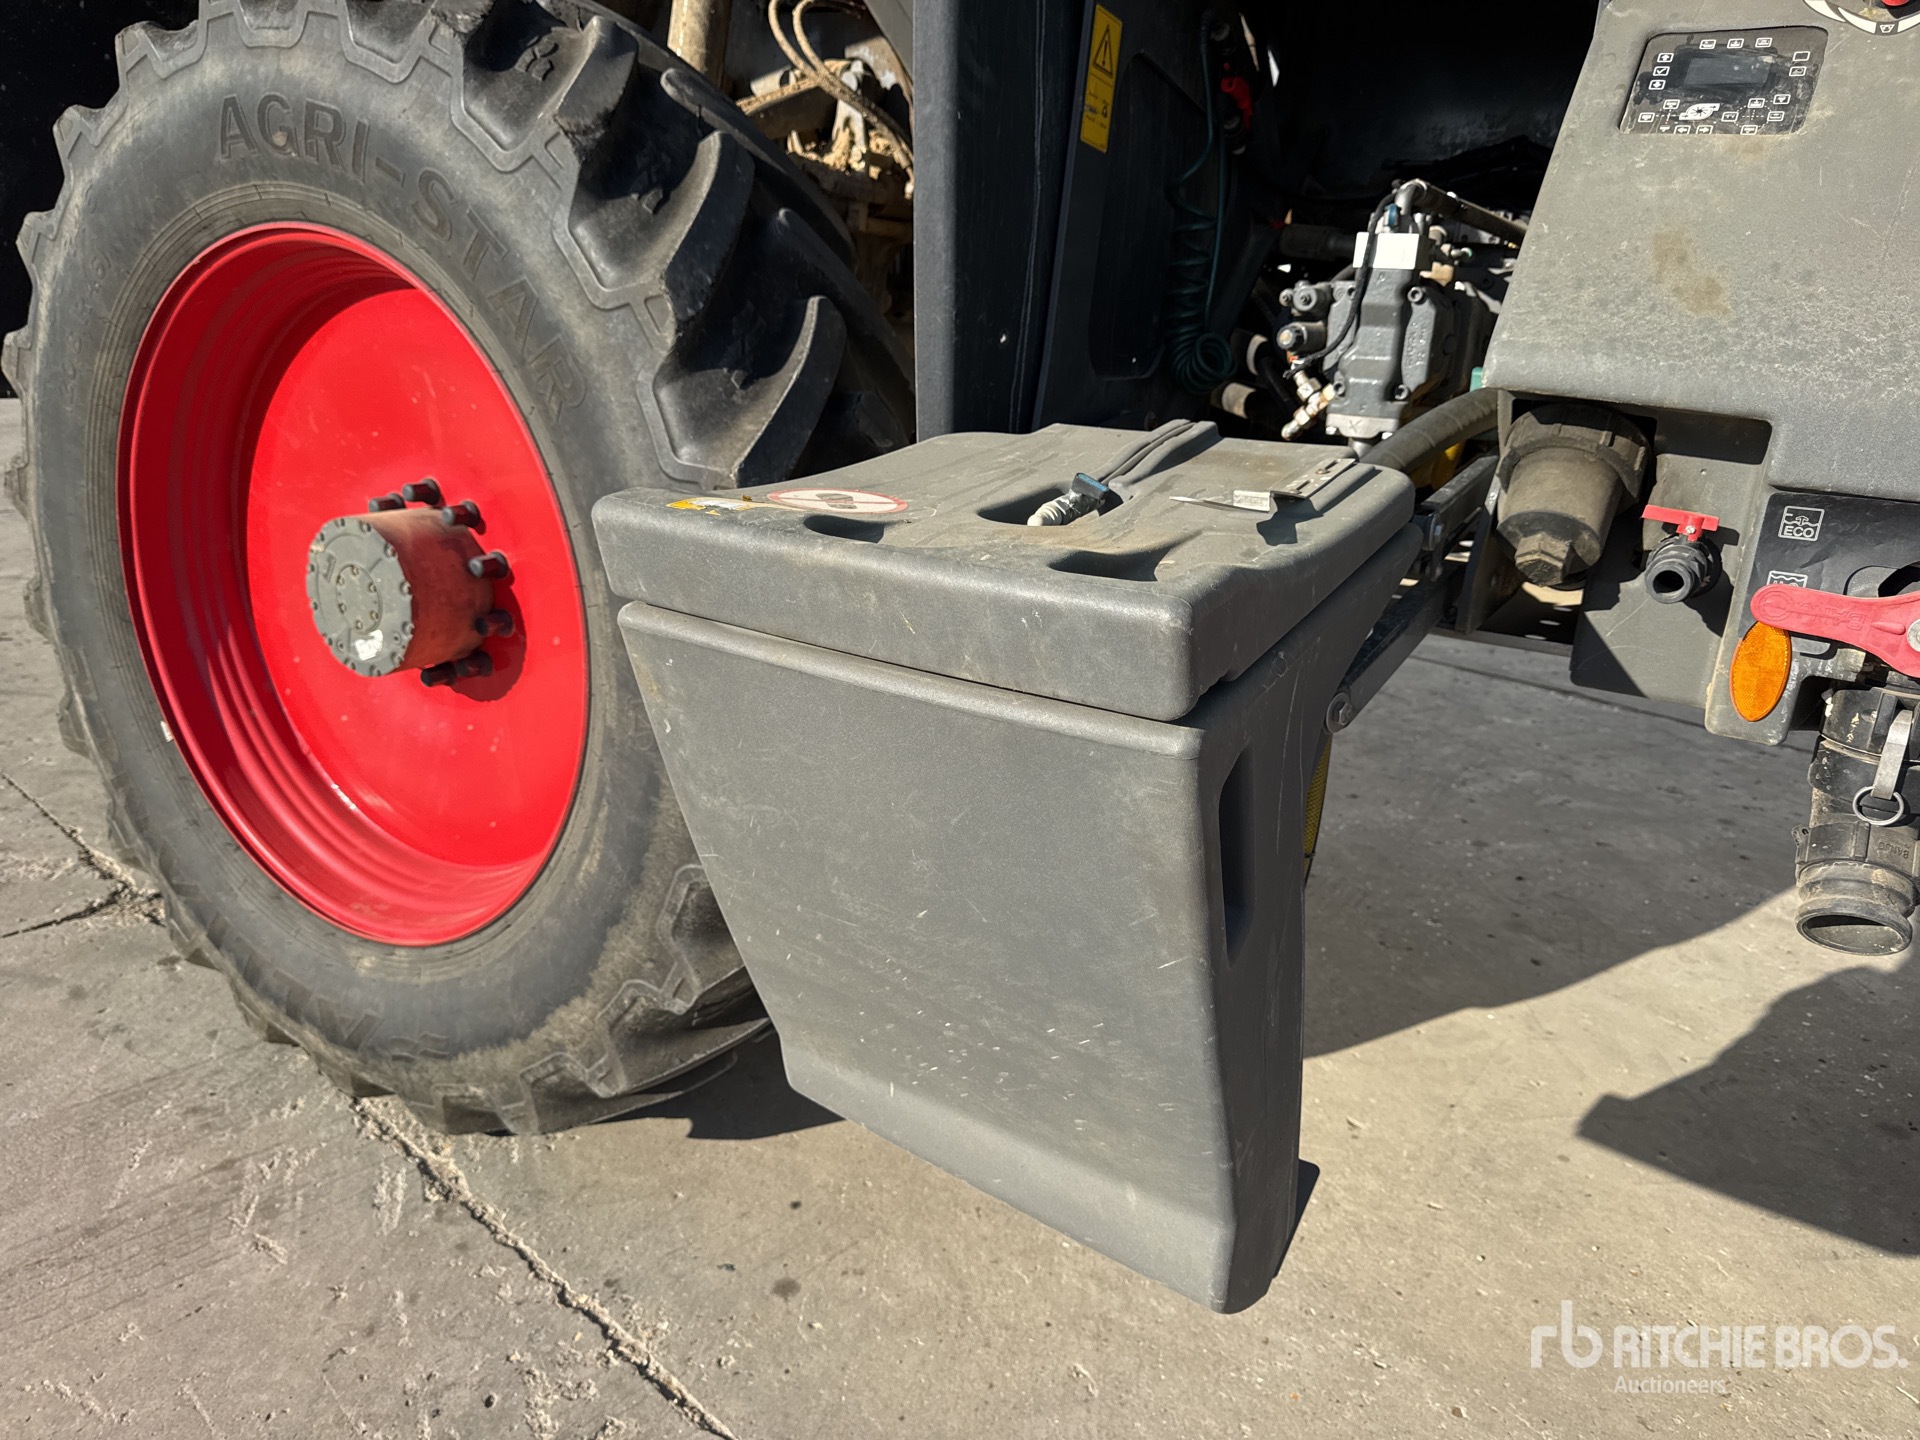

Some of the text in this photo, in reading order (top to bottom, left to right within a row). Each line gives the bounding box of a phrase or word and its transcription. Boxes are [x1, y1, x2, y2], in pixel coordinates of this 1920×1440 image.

[217, 93, 588, 424] AGRI-STAR
[1783, 525, 1815, 539] ECO
[1877, 842, 1909, 859] BANJO
